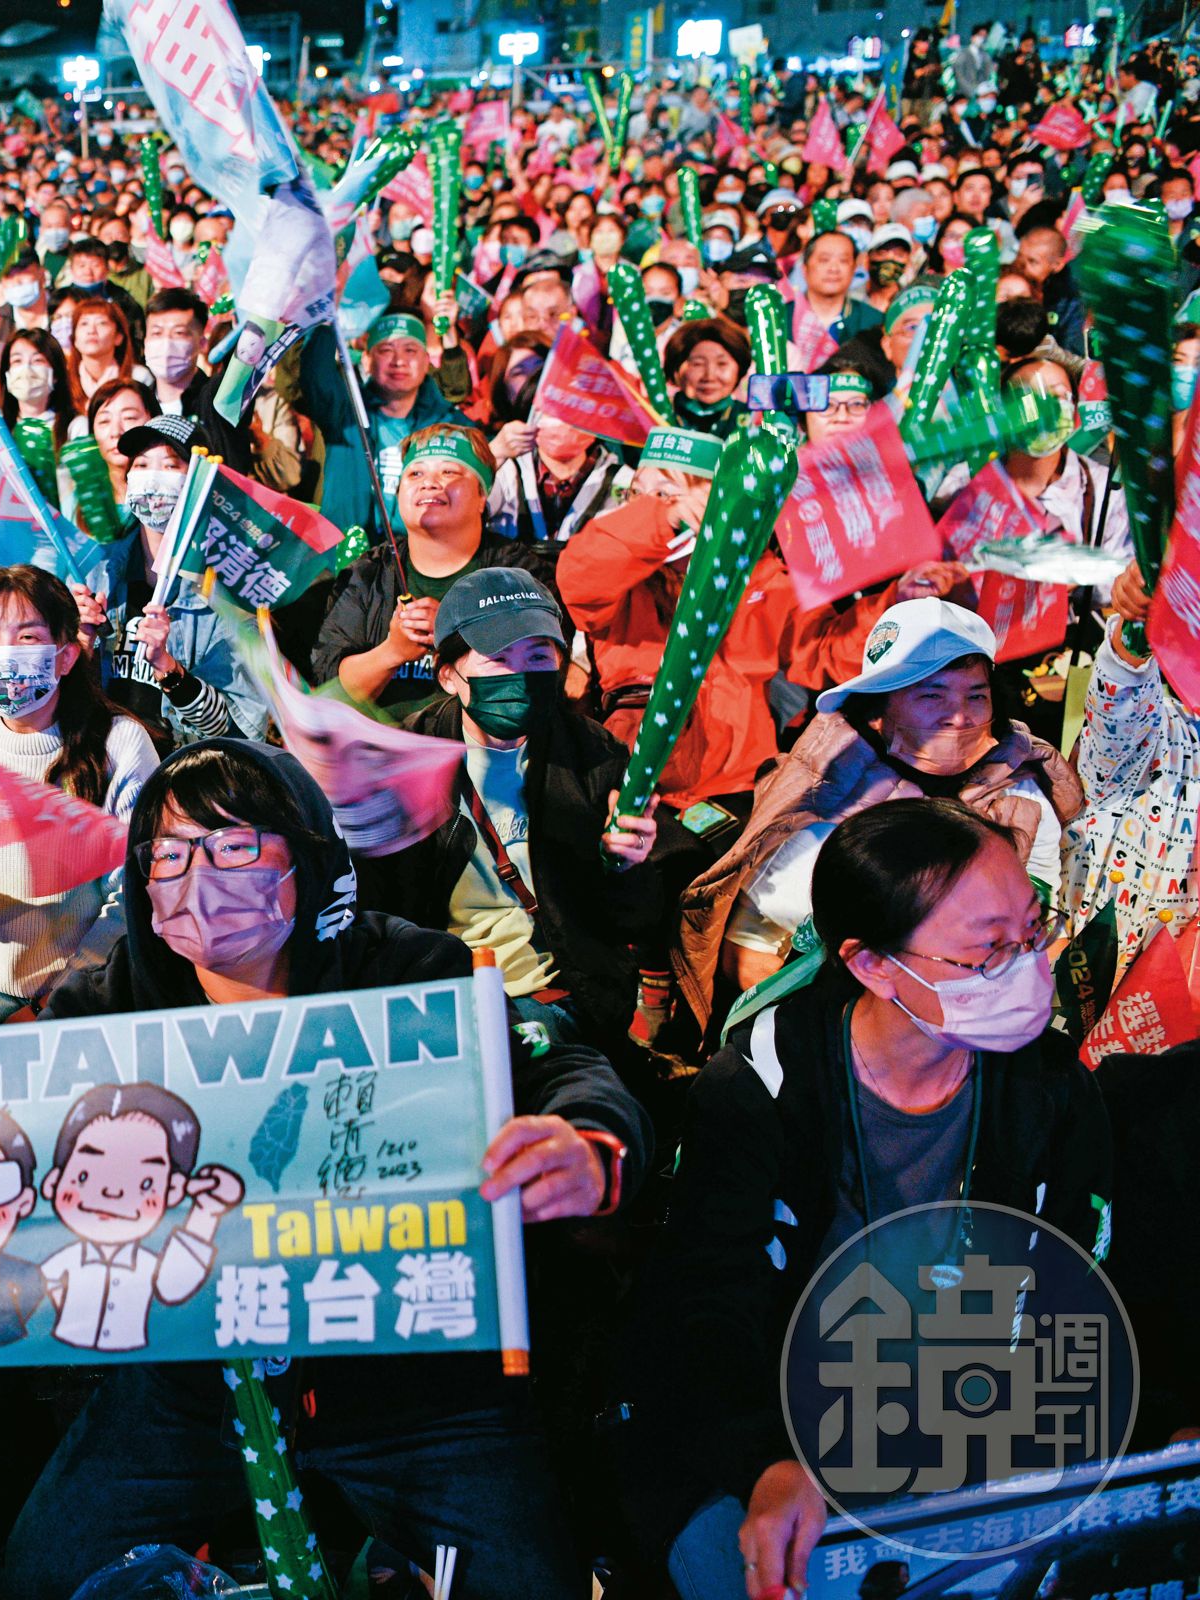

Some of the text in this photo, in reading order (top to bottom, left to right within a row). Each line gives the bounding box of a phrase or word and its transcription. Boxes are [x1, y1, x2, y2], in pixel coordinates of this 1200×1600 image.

[242, 1199, 467, 1259] Taiwan
[214, 1251, 477, 1348] 挺台灣
